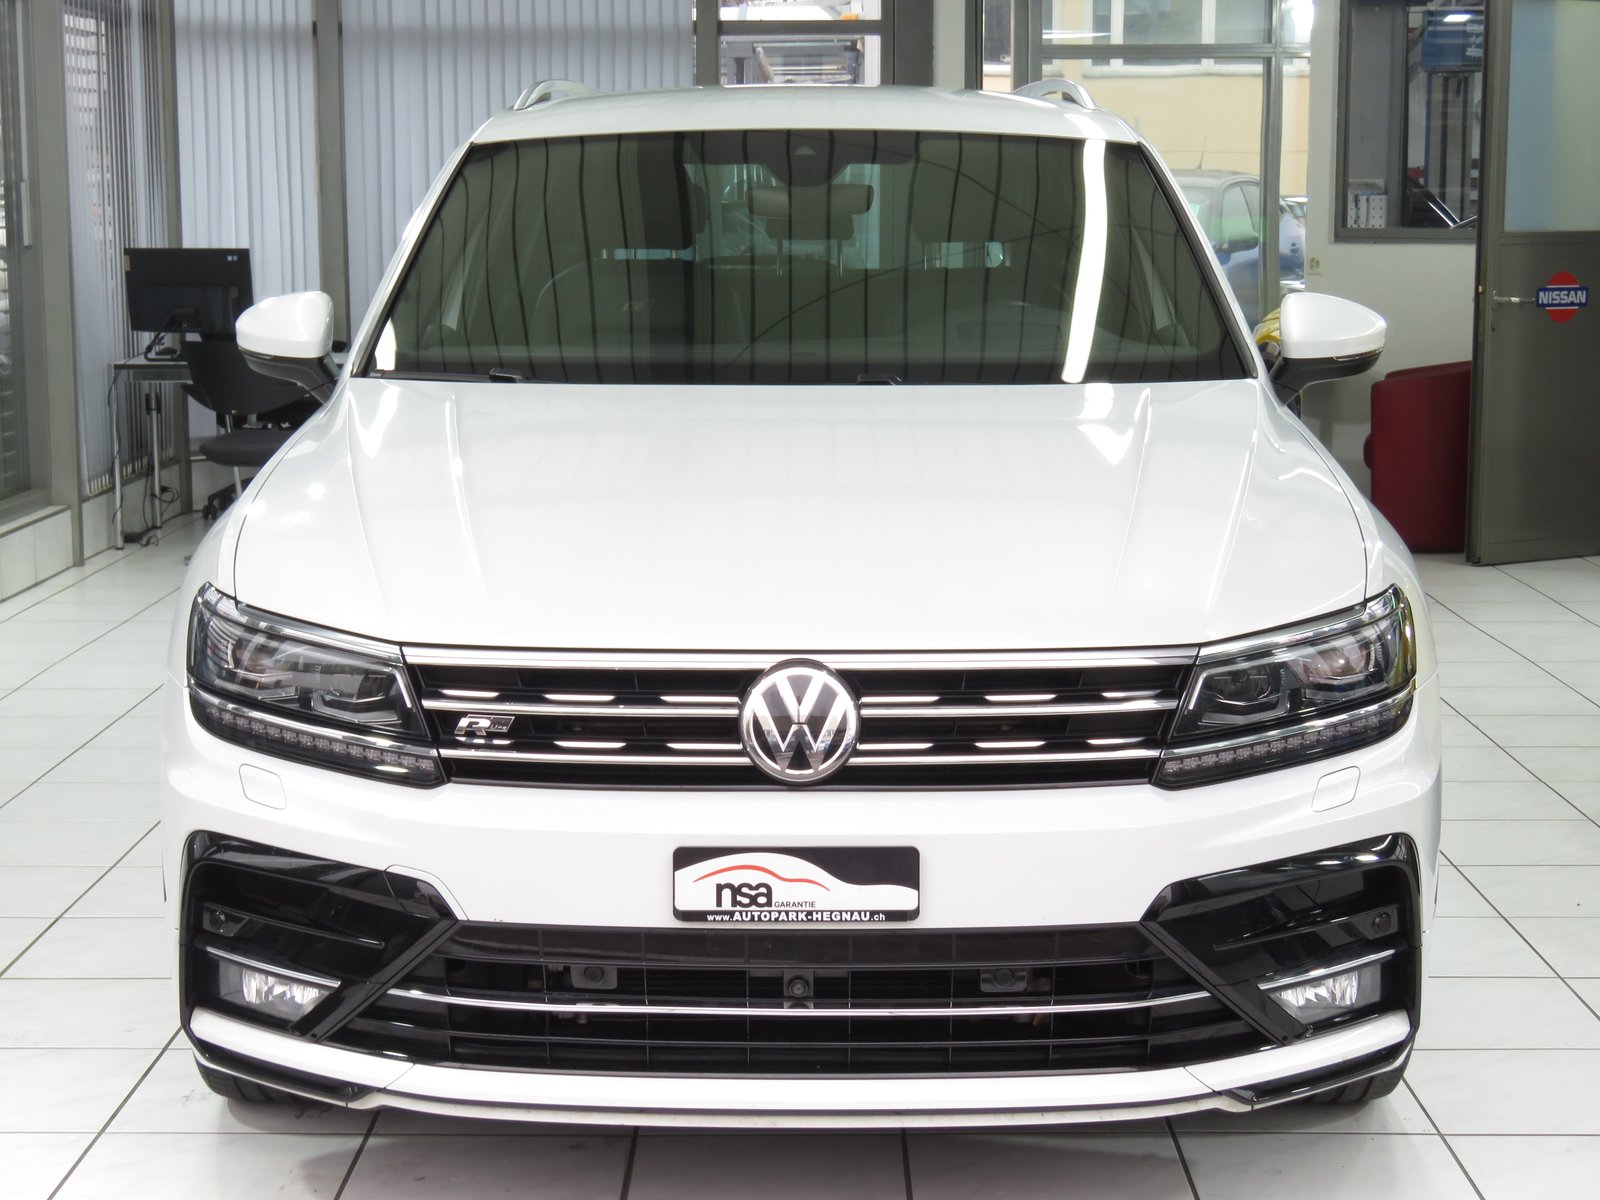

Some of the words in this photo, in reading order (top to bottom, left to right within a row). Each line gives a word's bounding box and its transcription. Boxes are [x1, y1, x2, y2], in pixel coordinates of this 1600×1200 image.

[1538, 290, 1587, 304] NISSAN
[716, 882, 773, 908] nsa
[707, 911, 886, 922] www.AUTOPARK-HEGNAU.ch
